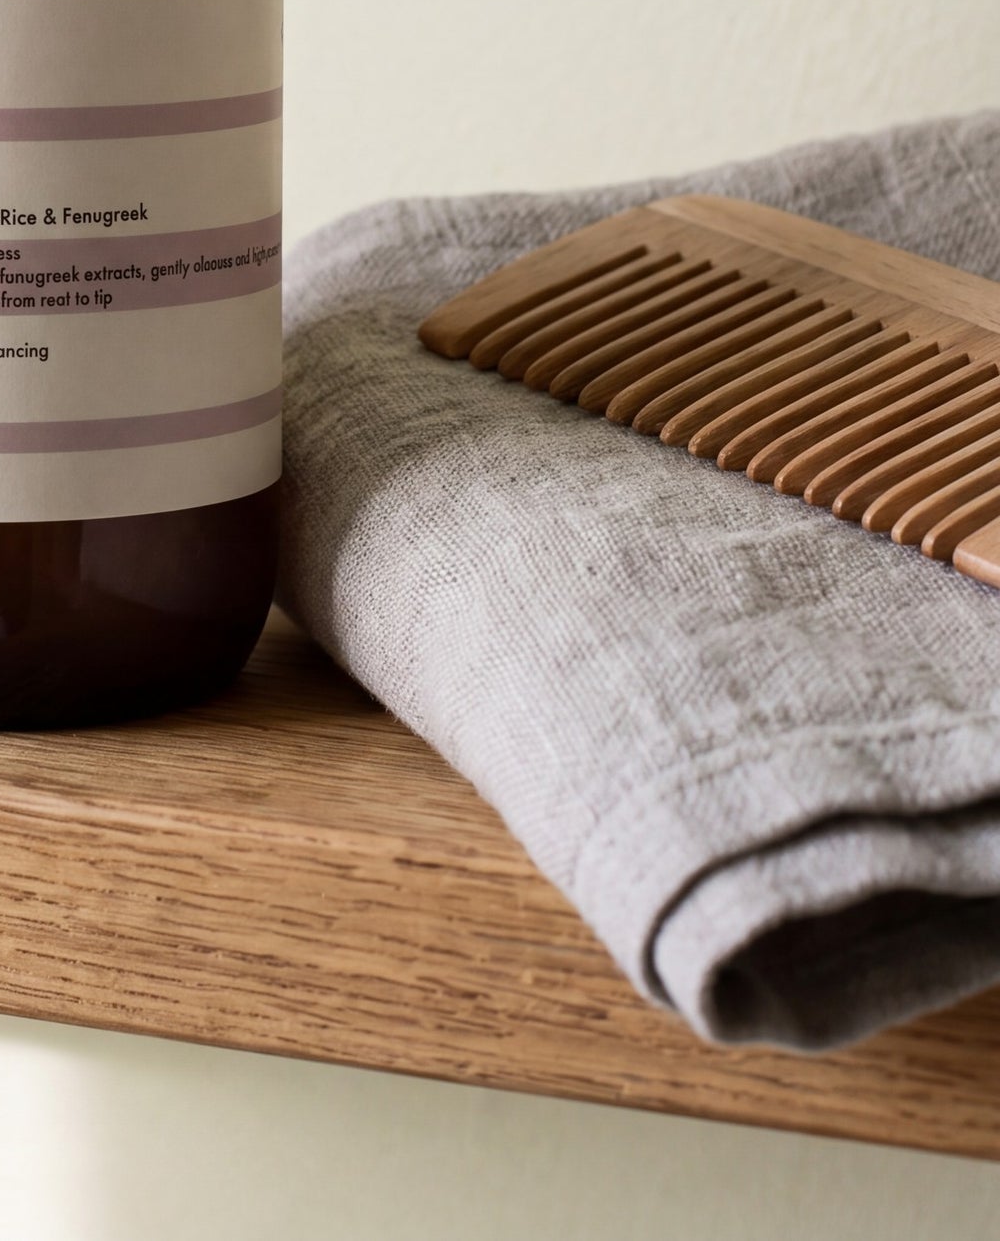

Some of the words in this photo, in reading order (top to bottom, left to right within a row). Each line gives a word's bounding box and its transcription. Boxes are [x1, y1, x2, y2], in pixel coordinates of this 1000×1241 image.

[0, 208, 37, 226] Rice
[43, 207, 57, 226] &
[62, 202, 149, 228] Fenugreek
[83, 264, 146, 282] extracts,
[150, 258, 191, 282] gently
[0, 290, 36, 308] from
[74, 291, 90, 306] to
[93, 288, 113, 310] tip
